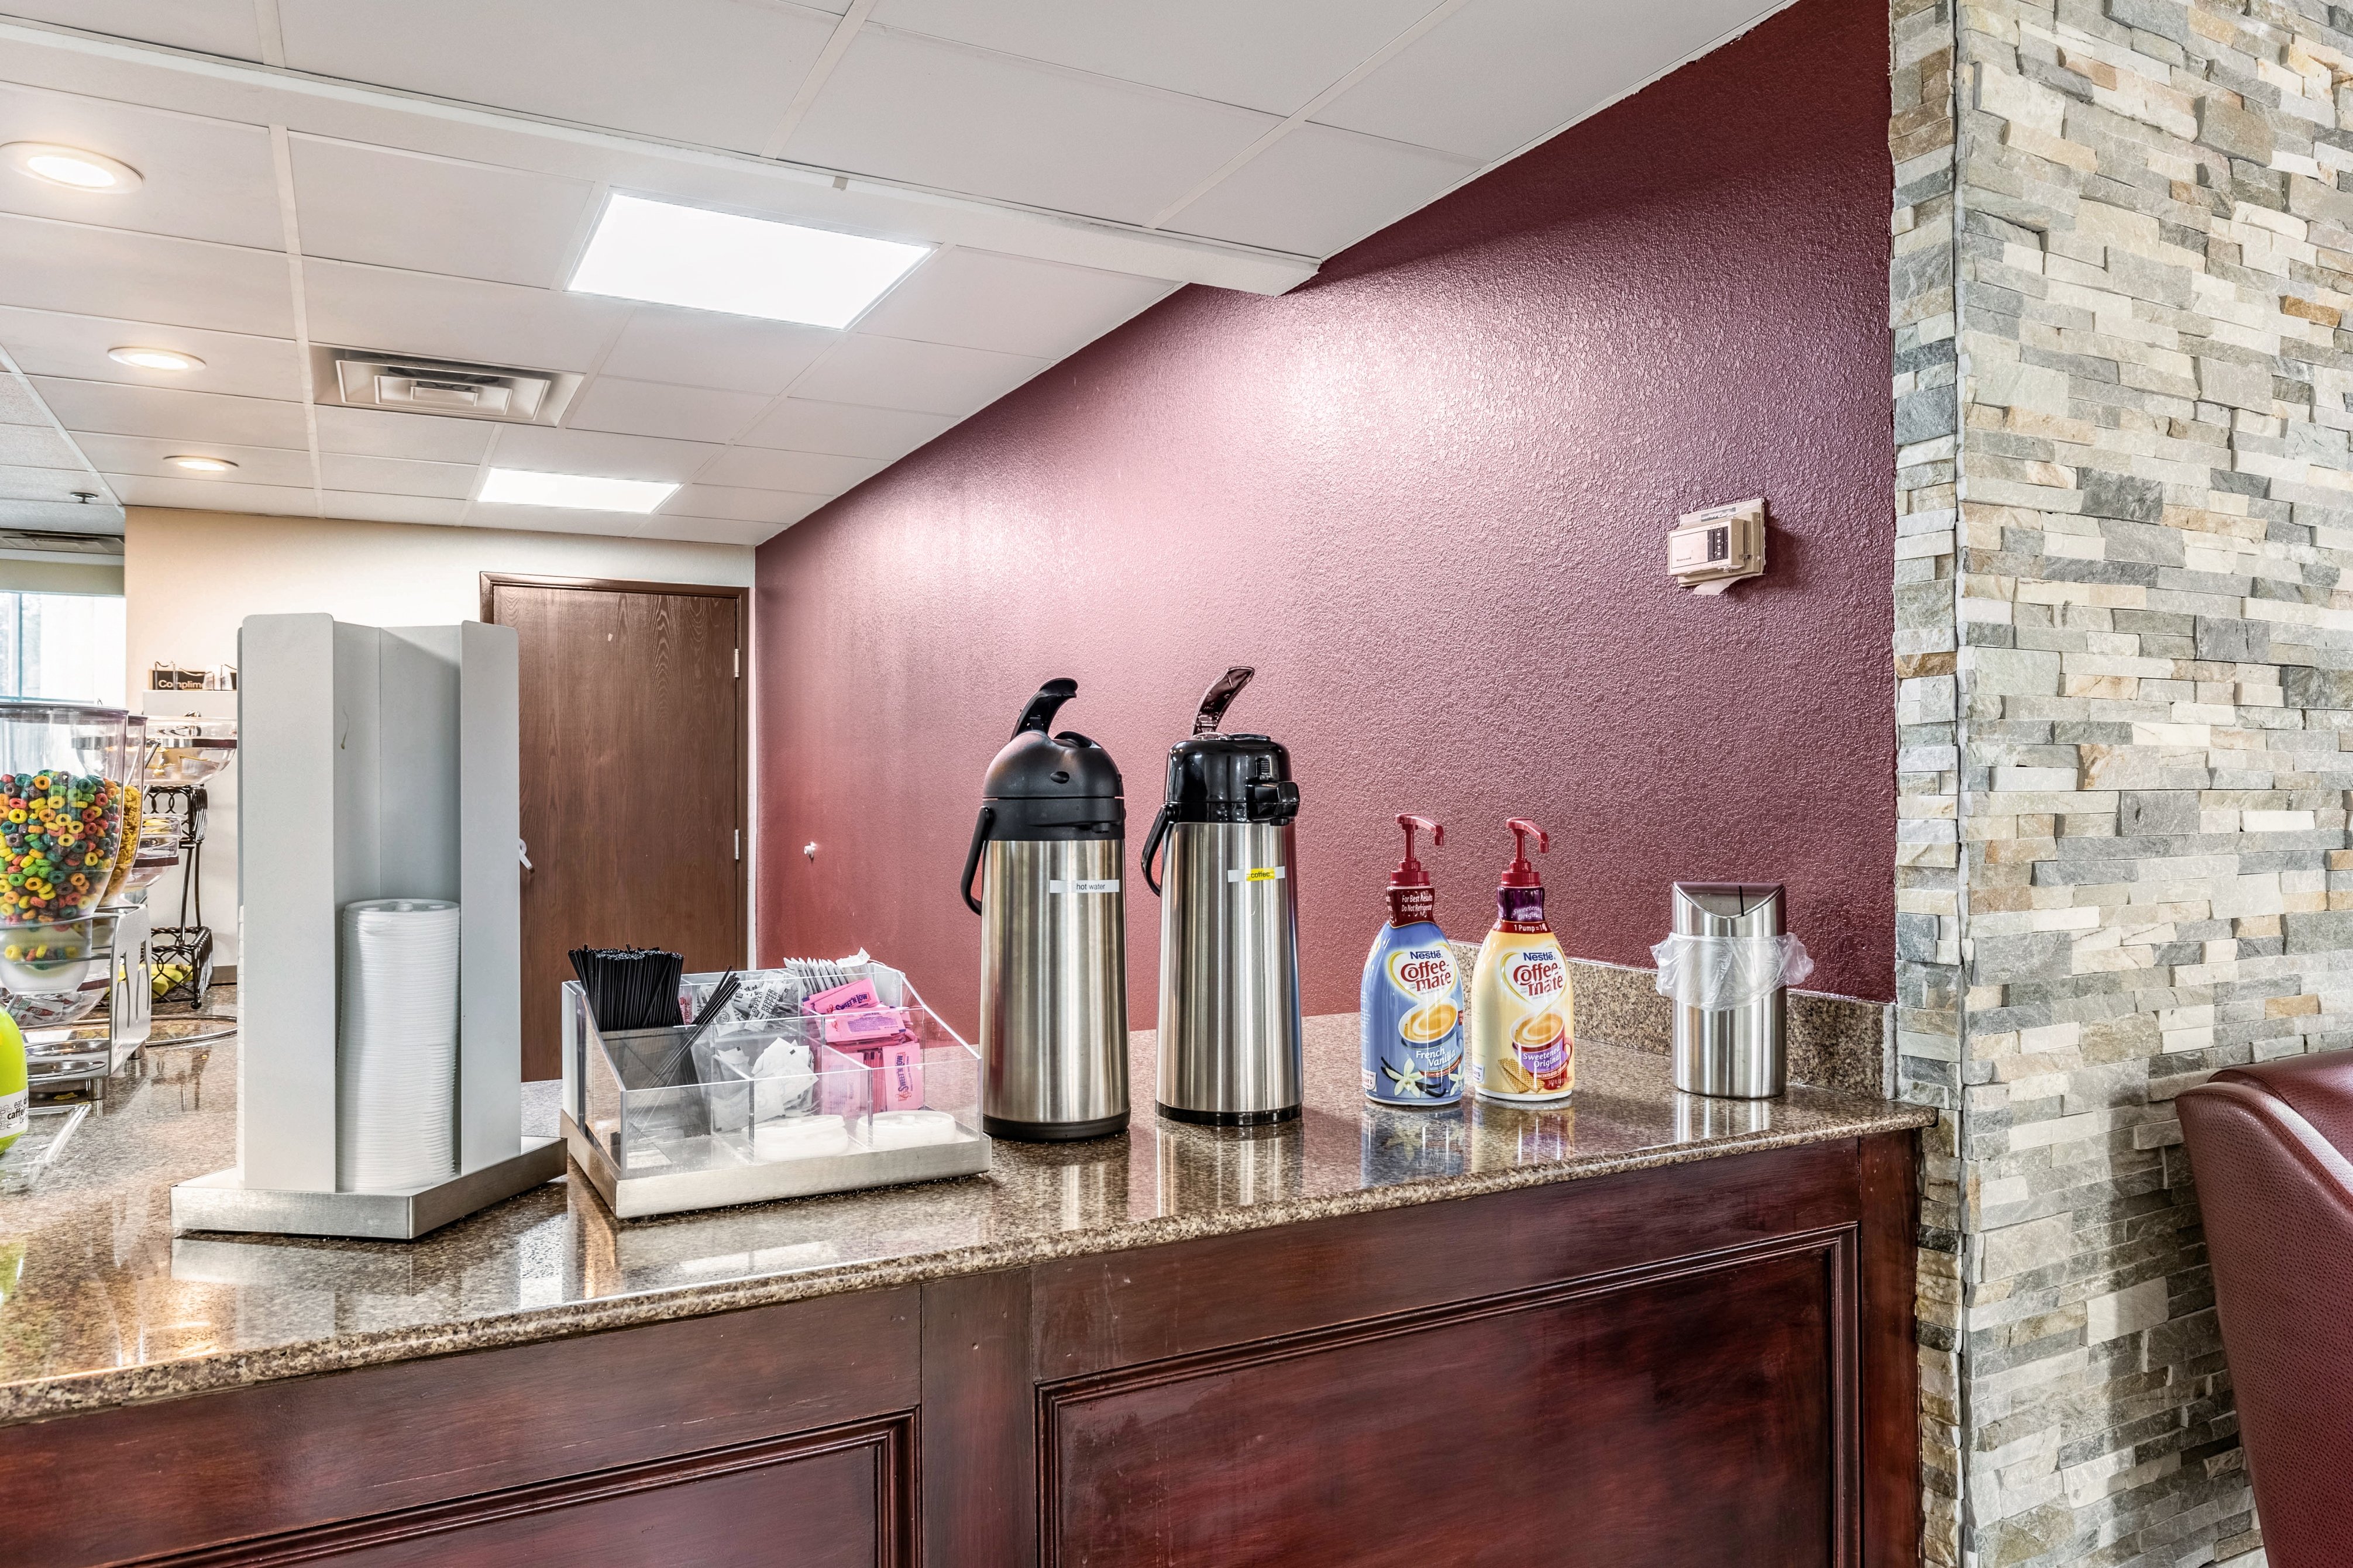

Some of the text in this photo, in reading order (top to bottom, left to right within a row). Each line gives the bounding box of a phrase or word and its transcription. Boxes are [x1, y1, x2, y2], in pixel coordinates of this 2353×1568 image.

[159, 680, 203, 689] Coplim
[1410, 950, 1441, 959] Nestlé
[1523, 952, 1553, 961] Nestlé
[1416, 972, 1451, 991] mate
[1528, 975, 1563, 996] mate
[751, 991, 763, 1013] PEPPER
[761, 988, 774, 1011] PEPPER
[1416, 1046, 1446, 1059] French
[1428, 1049, 1456, 1067] Vanilla
[1523, 1043, 1560, 1060] Sweetened
[1533, 1052, 1561, 1068] Original
[1534, 1070, 1557, 1078] ONCENTRATED
[14, 1099, 23, 1109] eat
[7, 1107, 26, 1120] caffei
